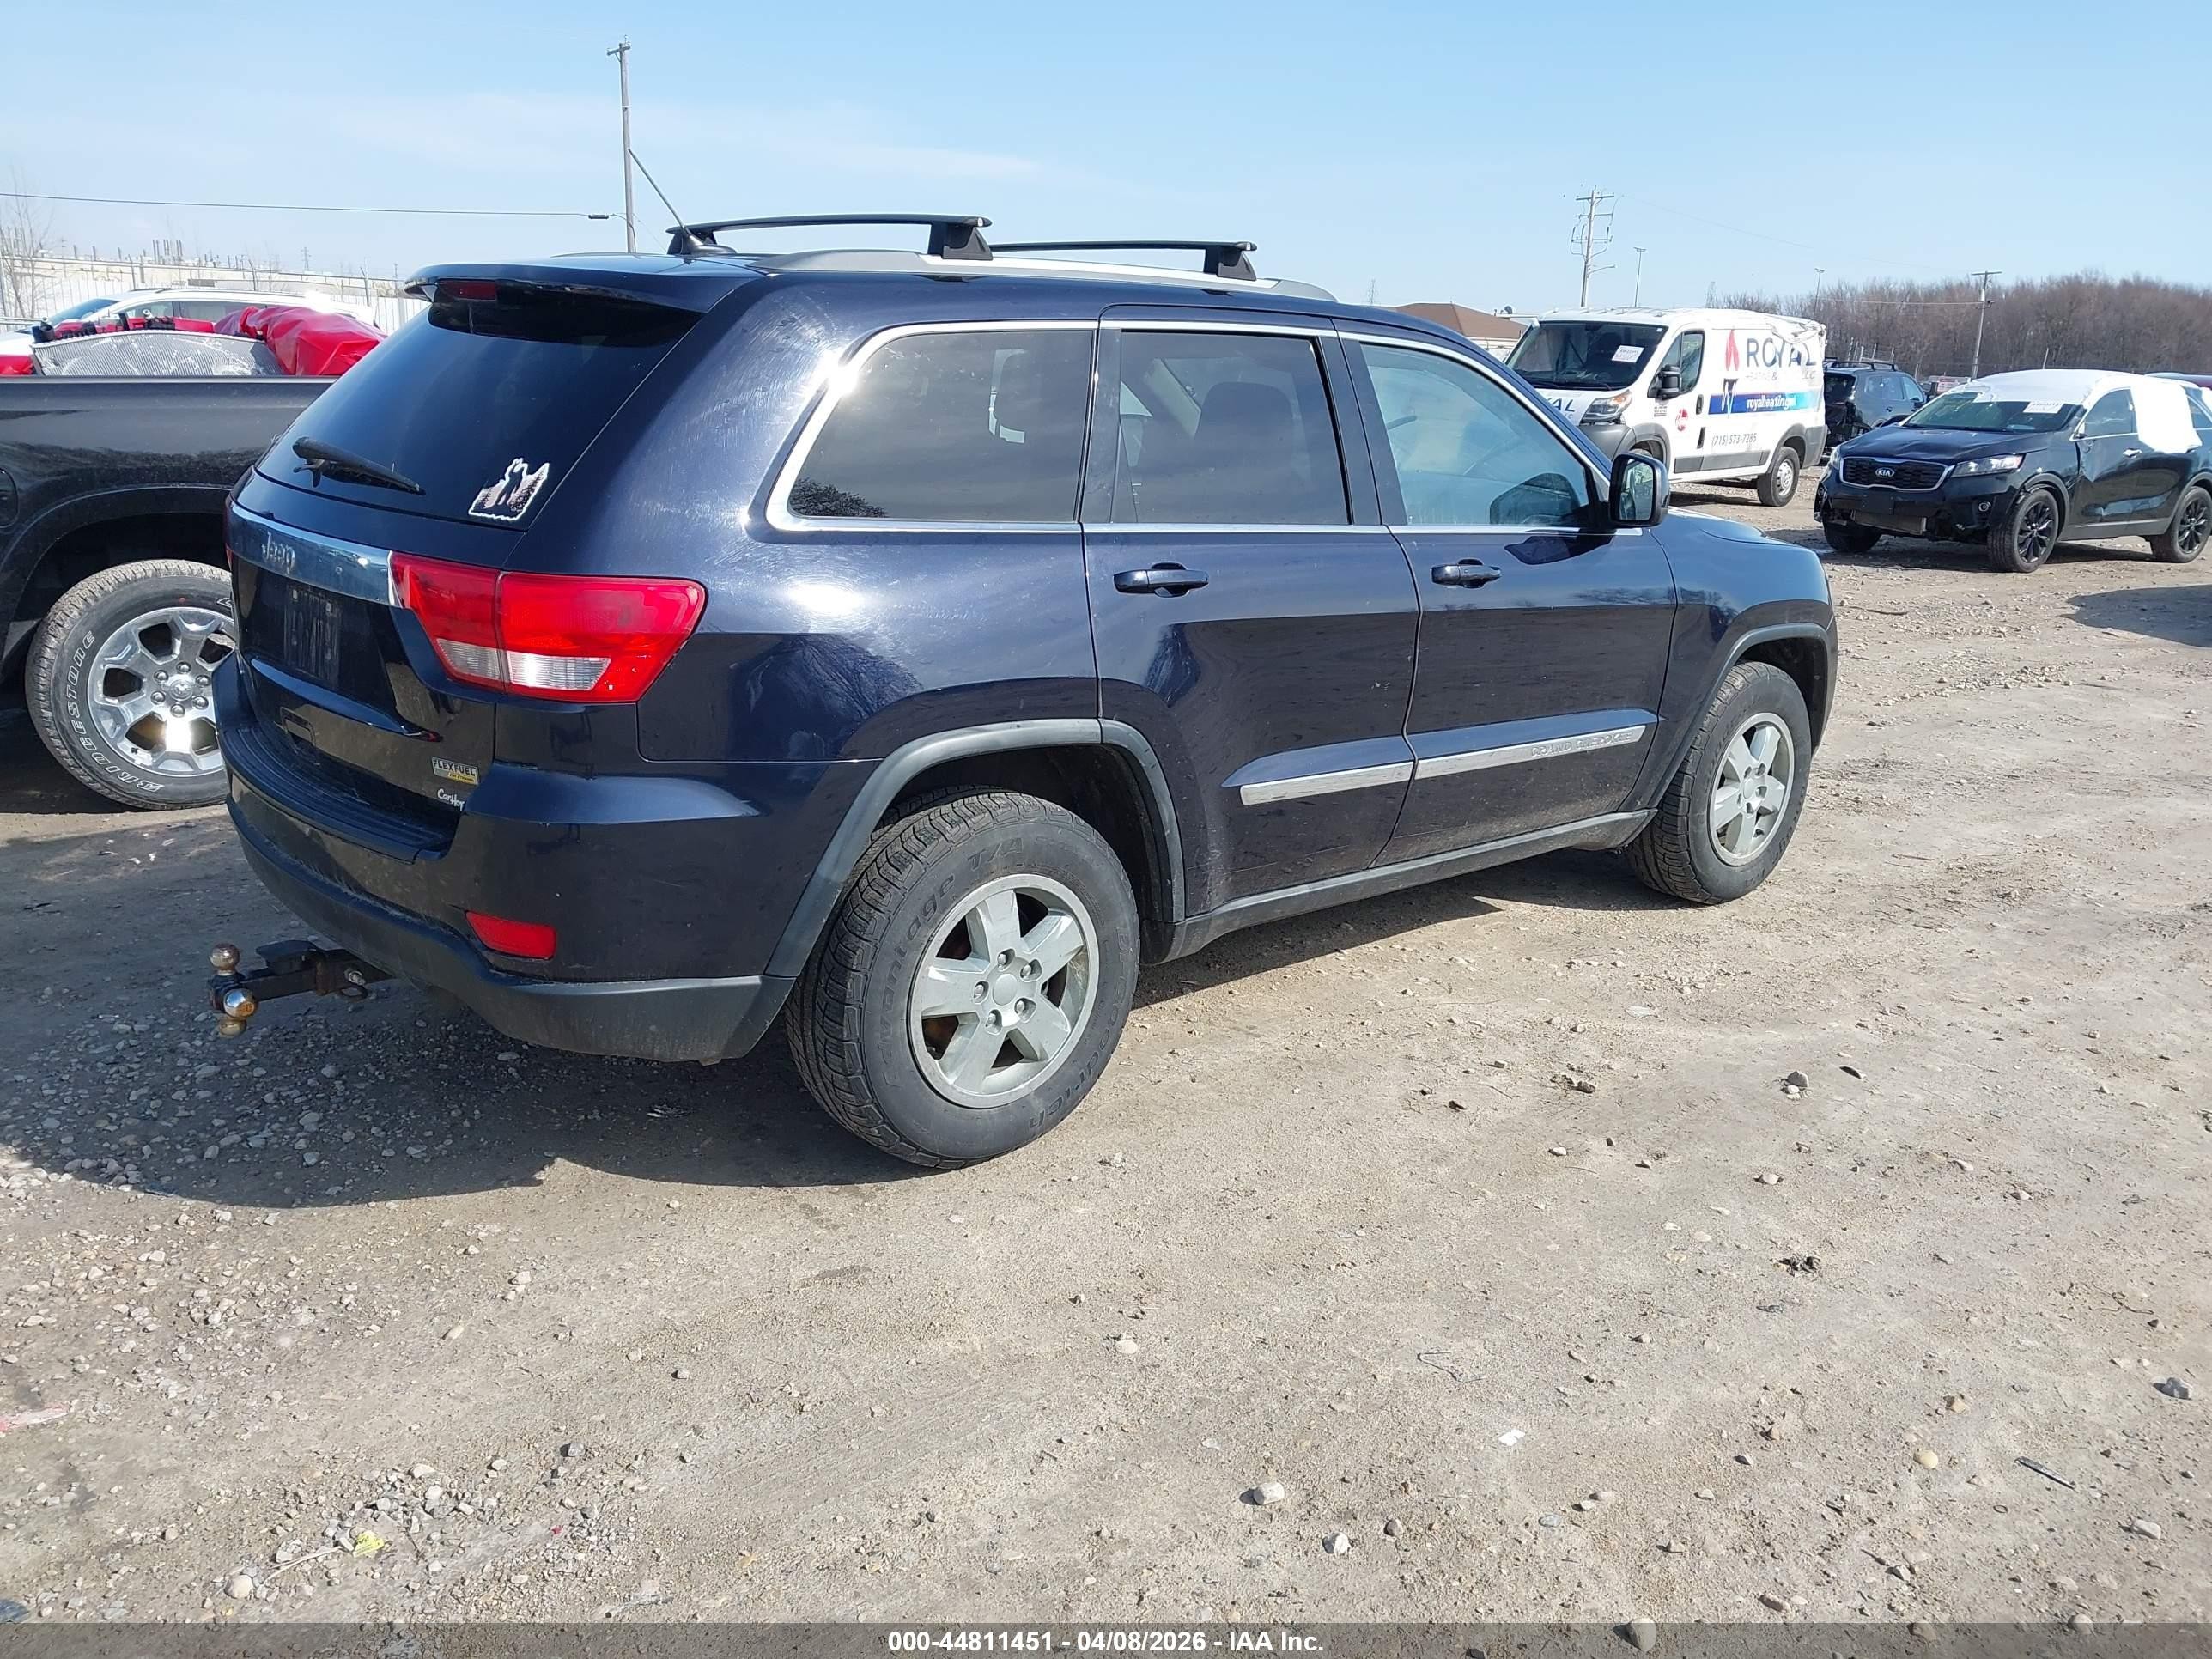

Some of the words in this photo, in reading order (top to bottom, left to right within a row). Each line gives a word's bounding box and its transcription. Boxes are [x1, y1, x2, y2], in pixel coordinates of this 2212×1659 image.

[1747, 337, 1816, 368] ROYAL
[261, 531, 295, 575] Jeep
[64, 629, 165, 793] BRIDGESTONE
